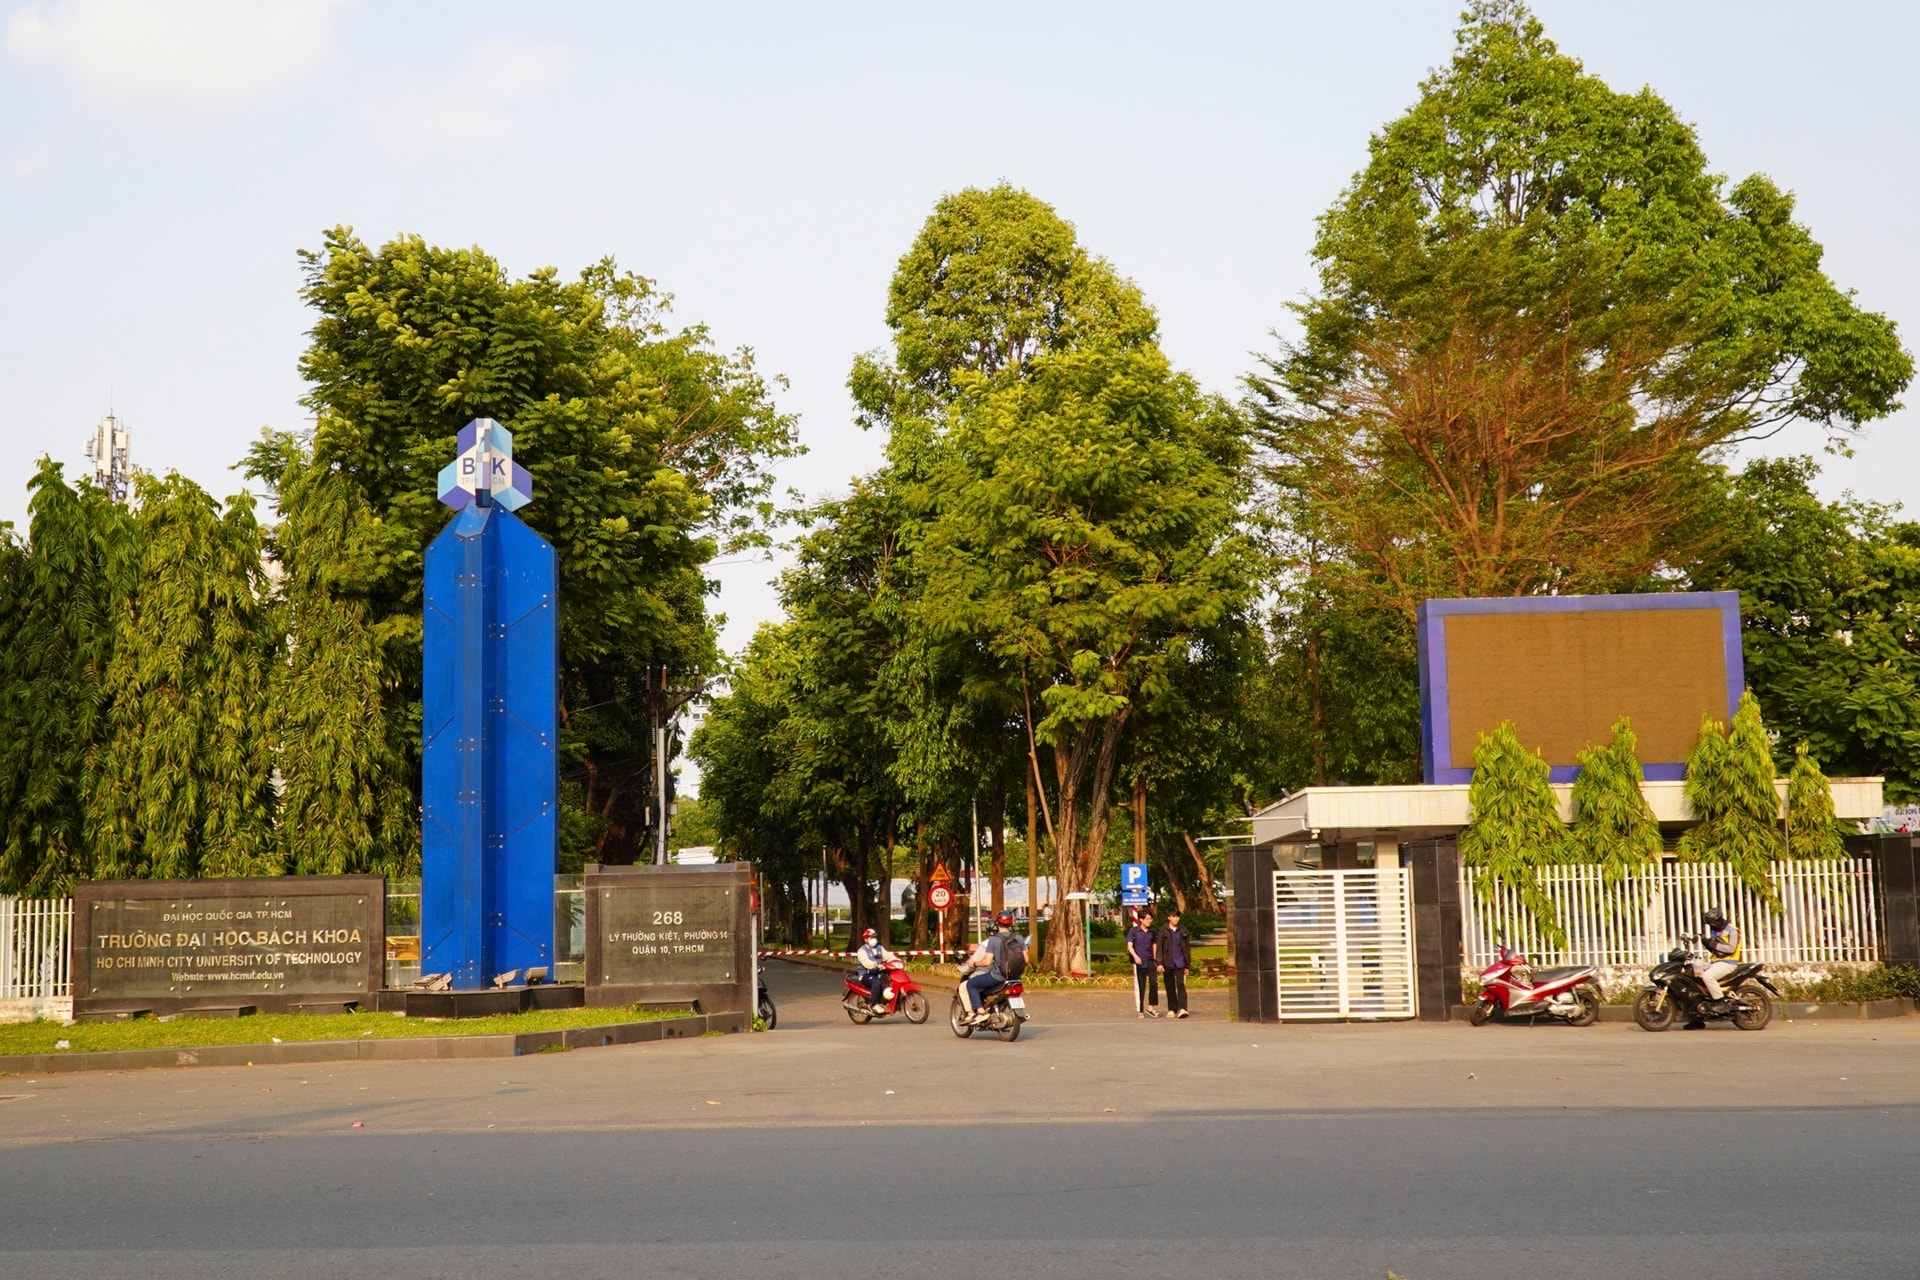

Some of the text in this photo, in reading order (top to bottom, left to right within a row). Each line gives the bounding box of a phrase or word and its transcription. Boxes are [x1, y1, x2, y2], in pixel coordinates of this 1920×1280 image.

[1128, 866, 1142, 884] P
[163, 913, 180, 923] ĐẠI
[182, 912, 203, 923] HỌC
[205, 909, 233, 920] QUỐC
[236, 911, 253, 919] GIA
[653, 911, 683, 925] 268
[97, 926, 361, 950] TRƯỜNG ĐẠI HỌC BÁCH KHOA
[609, 931, 620, 942] LÝ
[622, 930, 656, 941] THƯỜNG
[684, 929, 718, 940] PHƯỜNG
[720, 931, 728, 939] 14
[632, 944, 657, 956] QUẬN
[673, 944, 704, 954] TP.HCM
[117, 956, 136, 968] CHI
[138, 956, 165, 968] MINH
[167, 955, 194, 968] CITY
[196, 954, 263, 967] UNIVERSITY
[265, 953, 281, 965] OF
[284, 951, 362, 966] TECHNOLOGY
